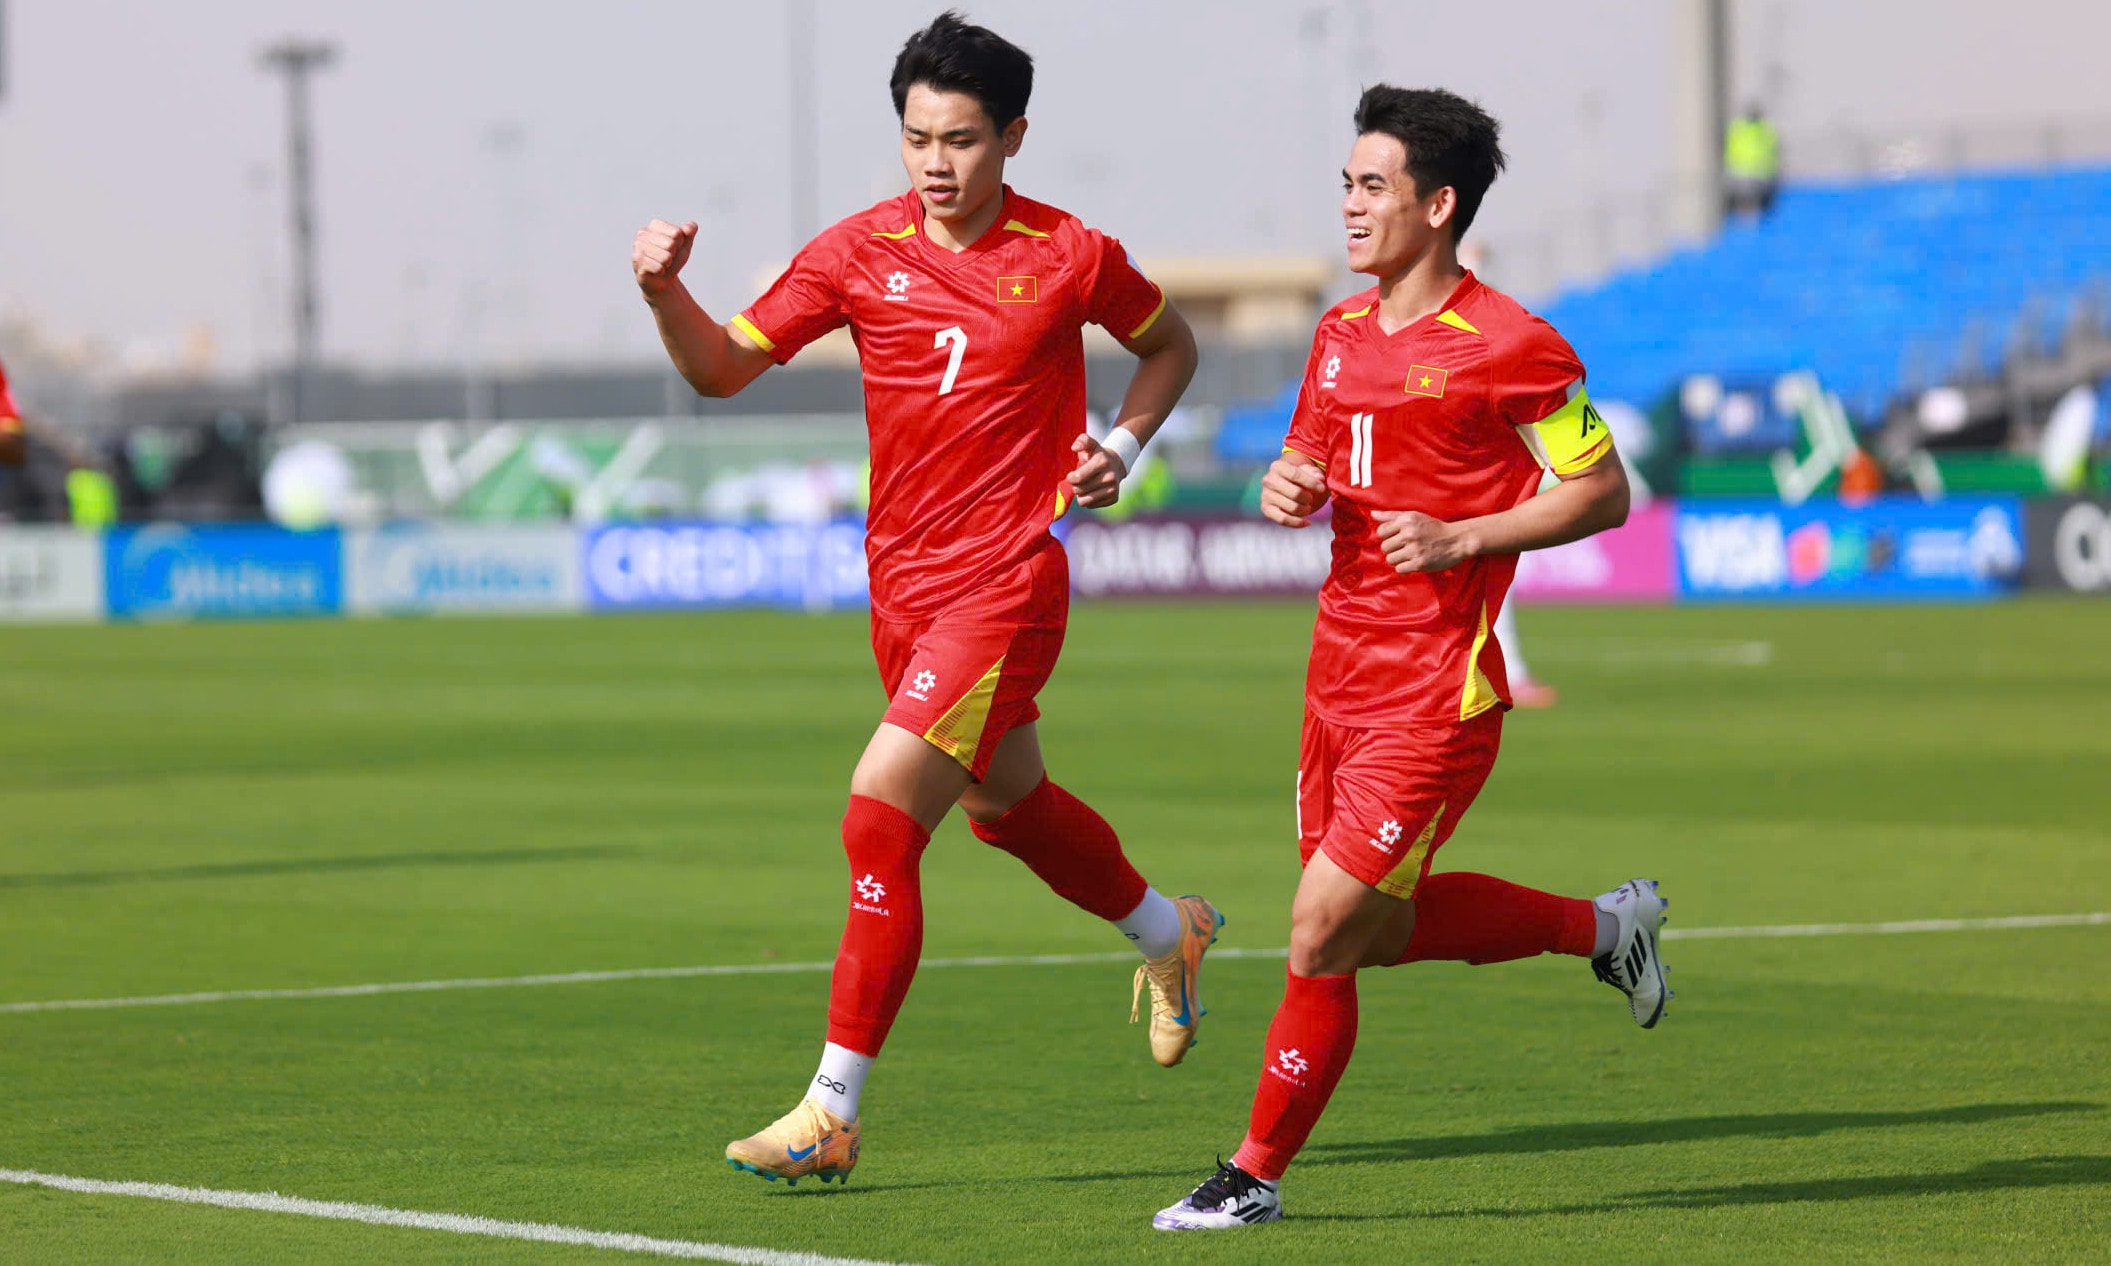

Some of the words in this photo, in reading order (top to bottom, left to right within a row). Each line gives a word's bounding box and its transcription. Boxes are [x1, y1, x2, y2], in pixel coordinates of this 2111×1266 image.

[933, 326, 968, 396] 7
[1350, 412, 1374, 489] 11
[1680, 512, 1787, 590] VISA
